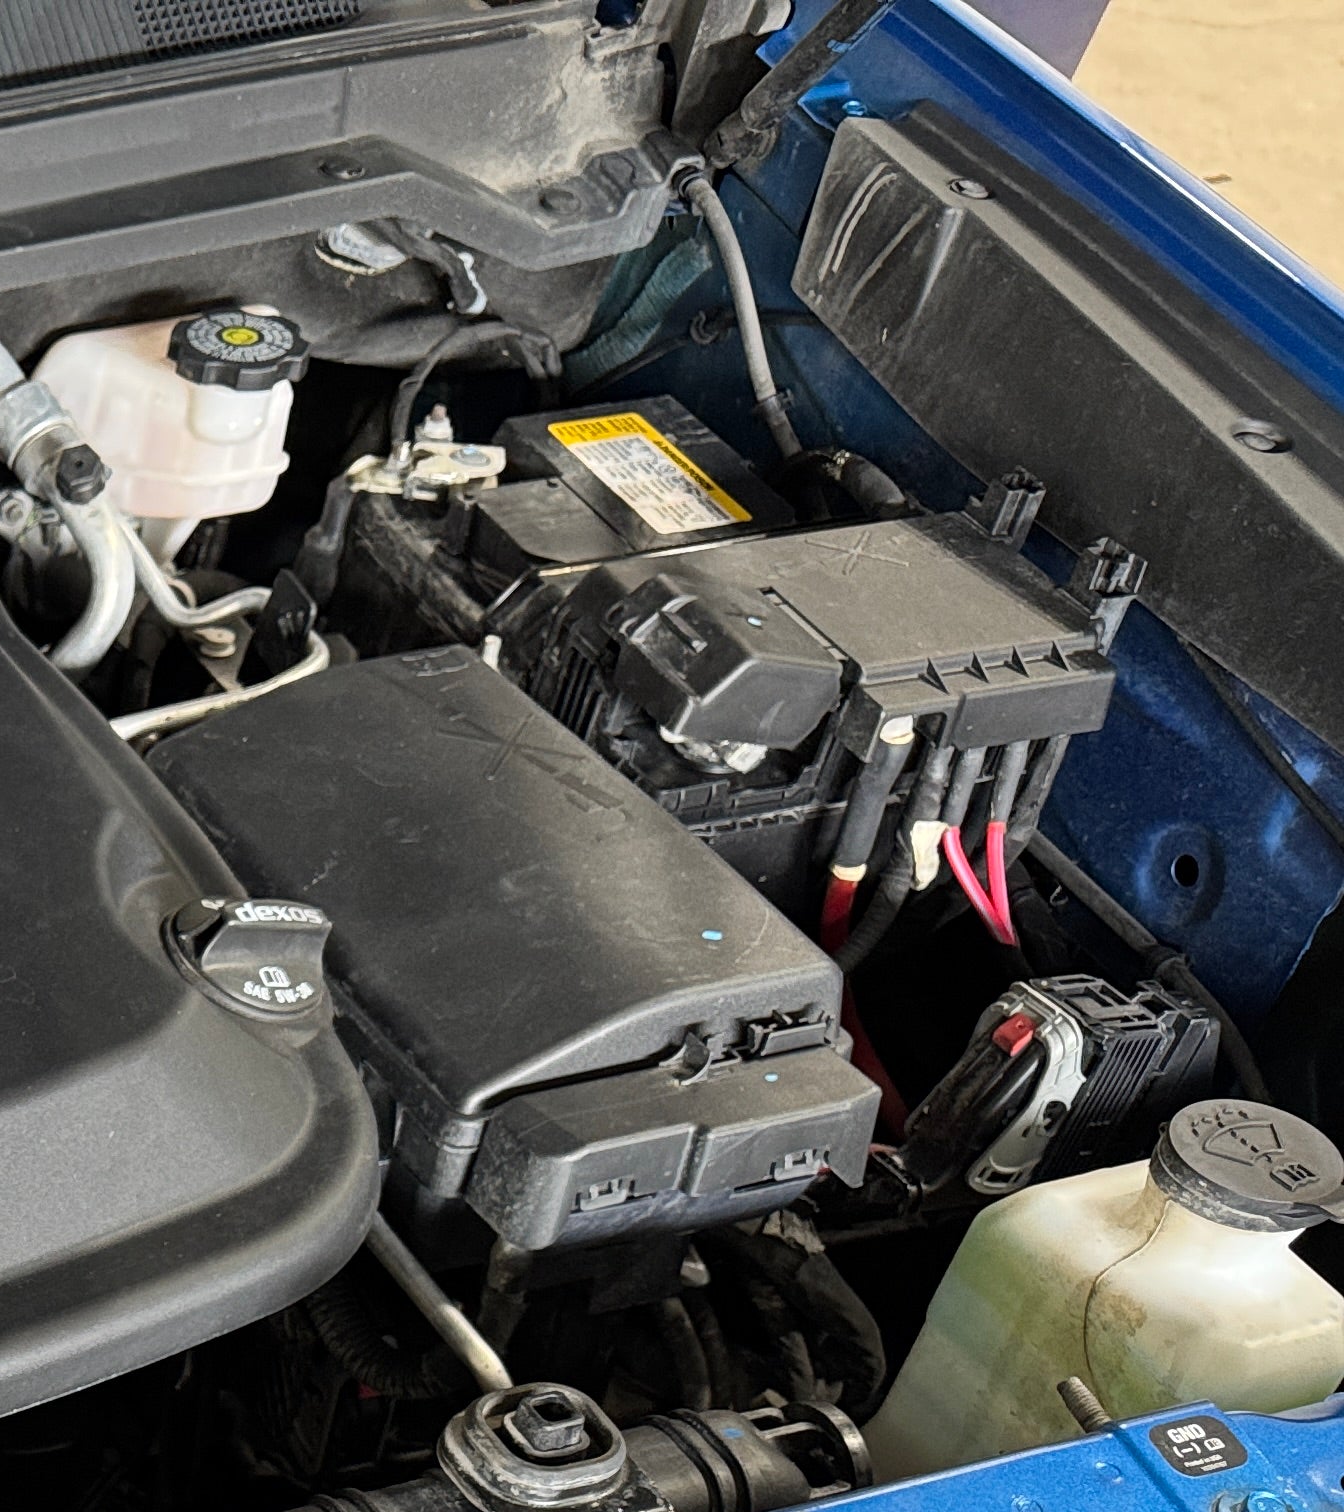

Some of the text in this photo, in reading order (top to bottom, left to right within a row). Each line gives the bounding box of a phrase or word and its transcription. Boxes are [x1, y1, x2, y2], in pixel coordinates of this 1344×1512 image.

[234, 901, 324, 925] dexos
[243, 980, 272, 1002] SAE
[1166, 1422, 1206, 1444] GND
